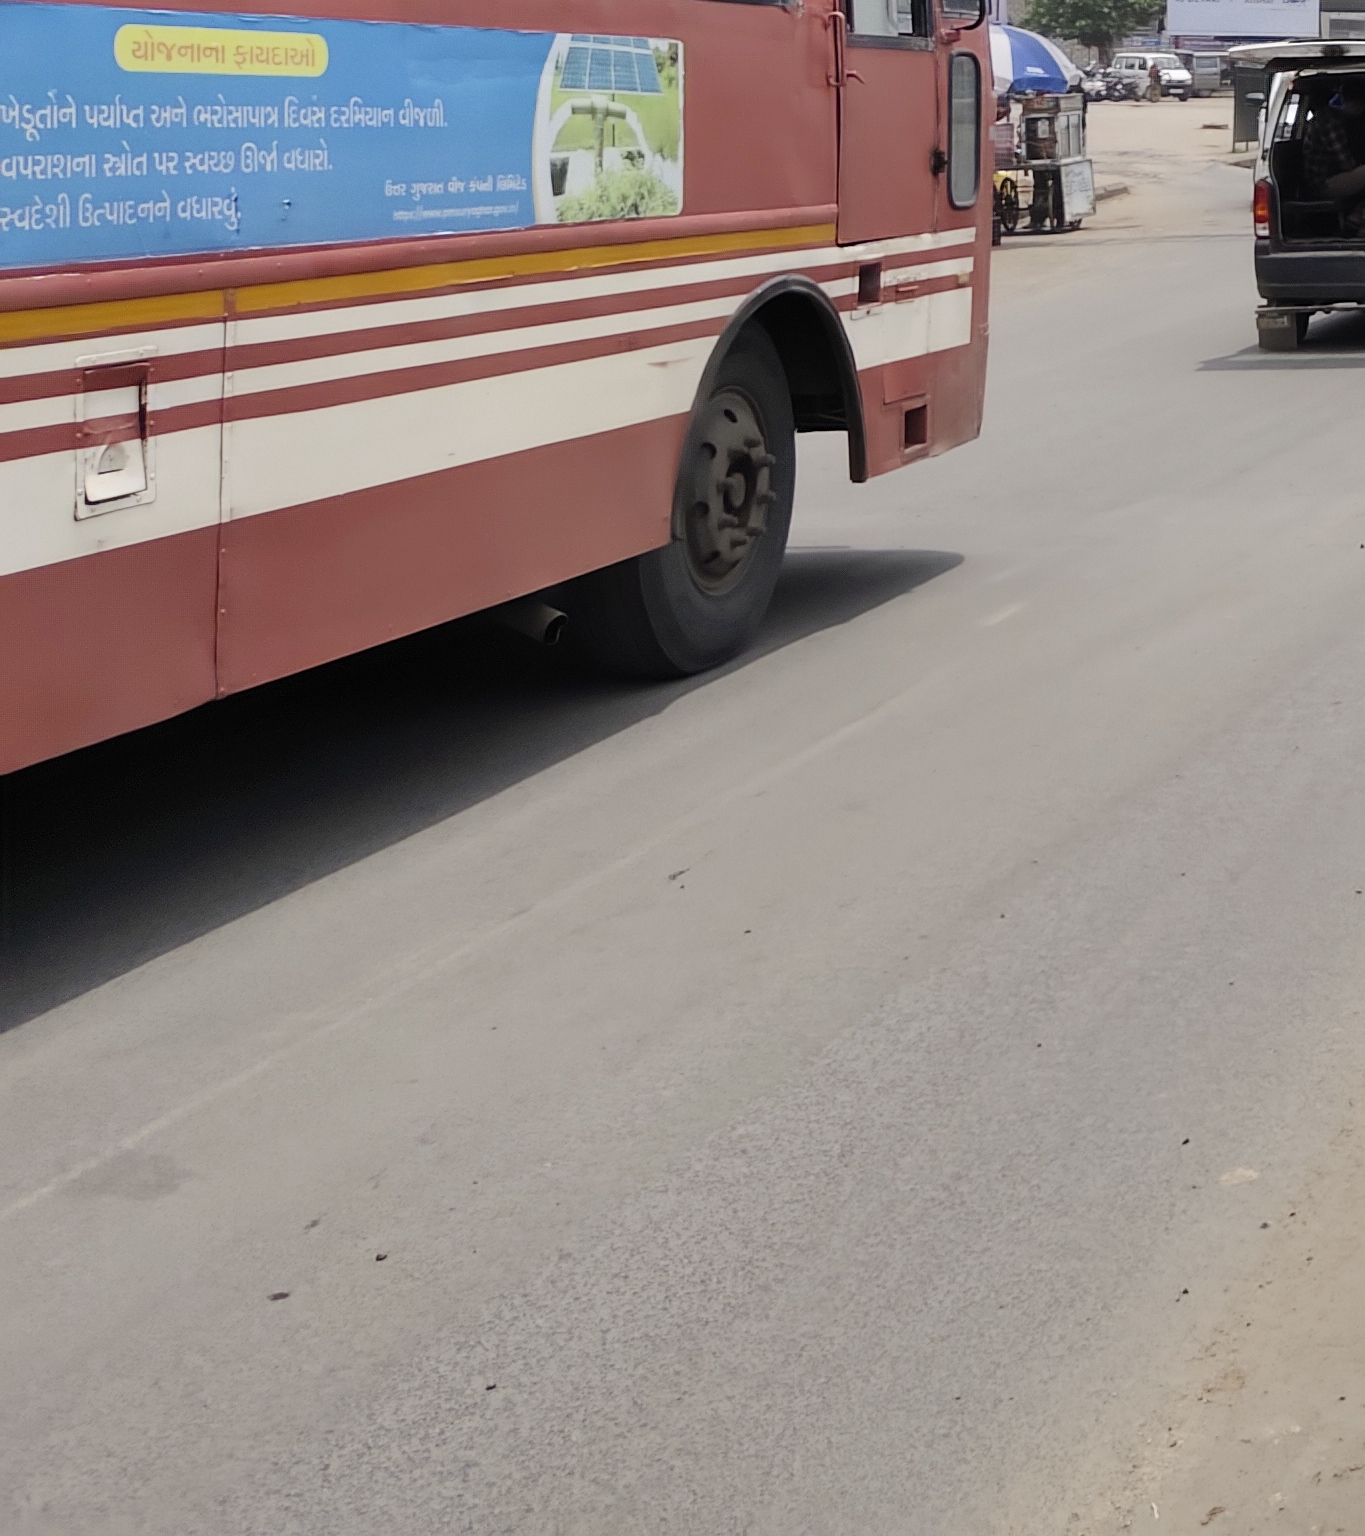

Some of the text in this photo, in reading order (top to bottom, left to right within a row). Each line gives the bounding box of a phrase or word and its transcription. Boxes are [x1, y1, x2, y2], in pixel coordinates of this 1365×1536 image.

[132, 30, 315, 70] યોજનાના ફાયદાઓ
[84, 94, 144, 129] પર્યાપ્ત
[151, 96, 187, 128] અને
[193, 94, 279, 128] ભરોસાપાત્ર
[330, 97, 394, 128] દરમિયાન
[399, 98, 448, 128] વીજળી.
[0, 154, 97, 180] વપરાશના
[153, 151, 179, 175] પર
[184, 150, 235, 175] સ્વચ્છ
[283, 138, 333, 172] વધારો.
[78, 189, 171, 228] ઉત્પાદનને
